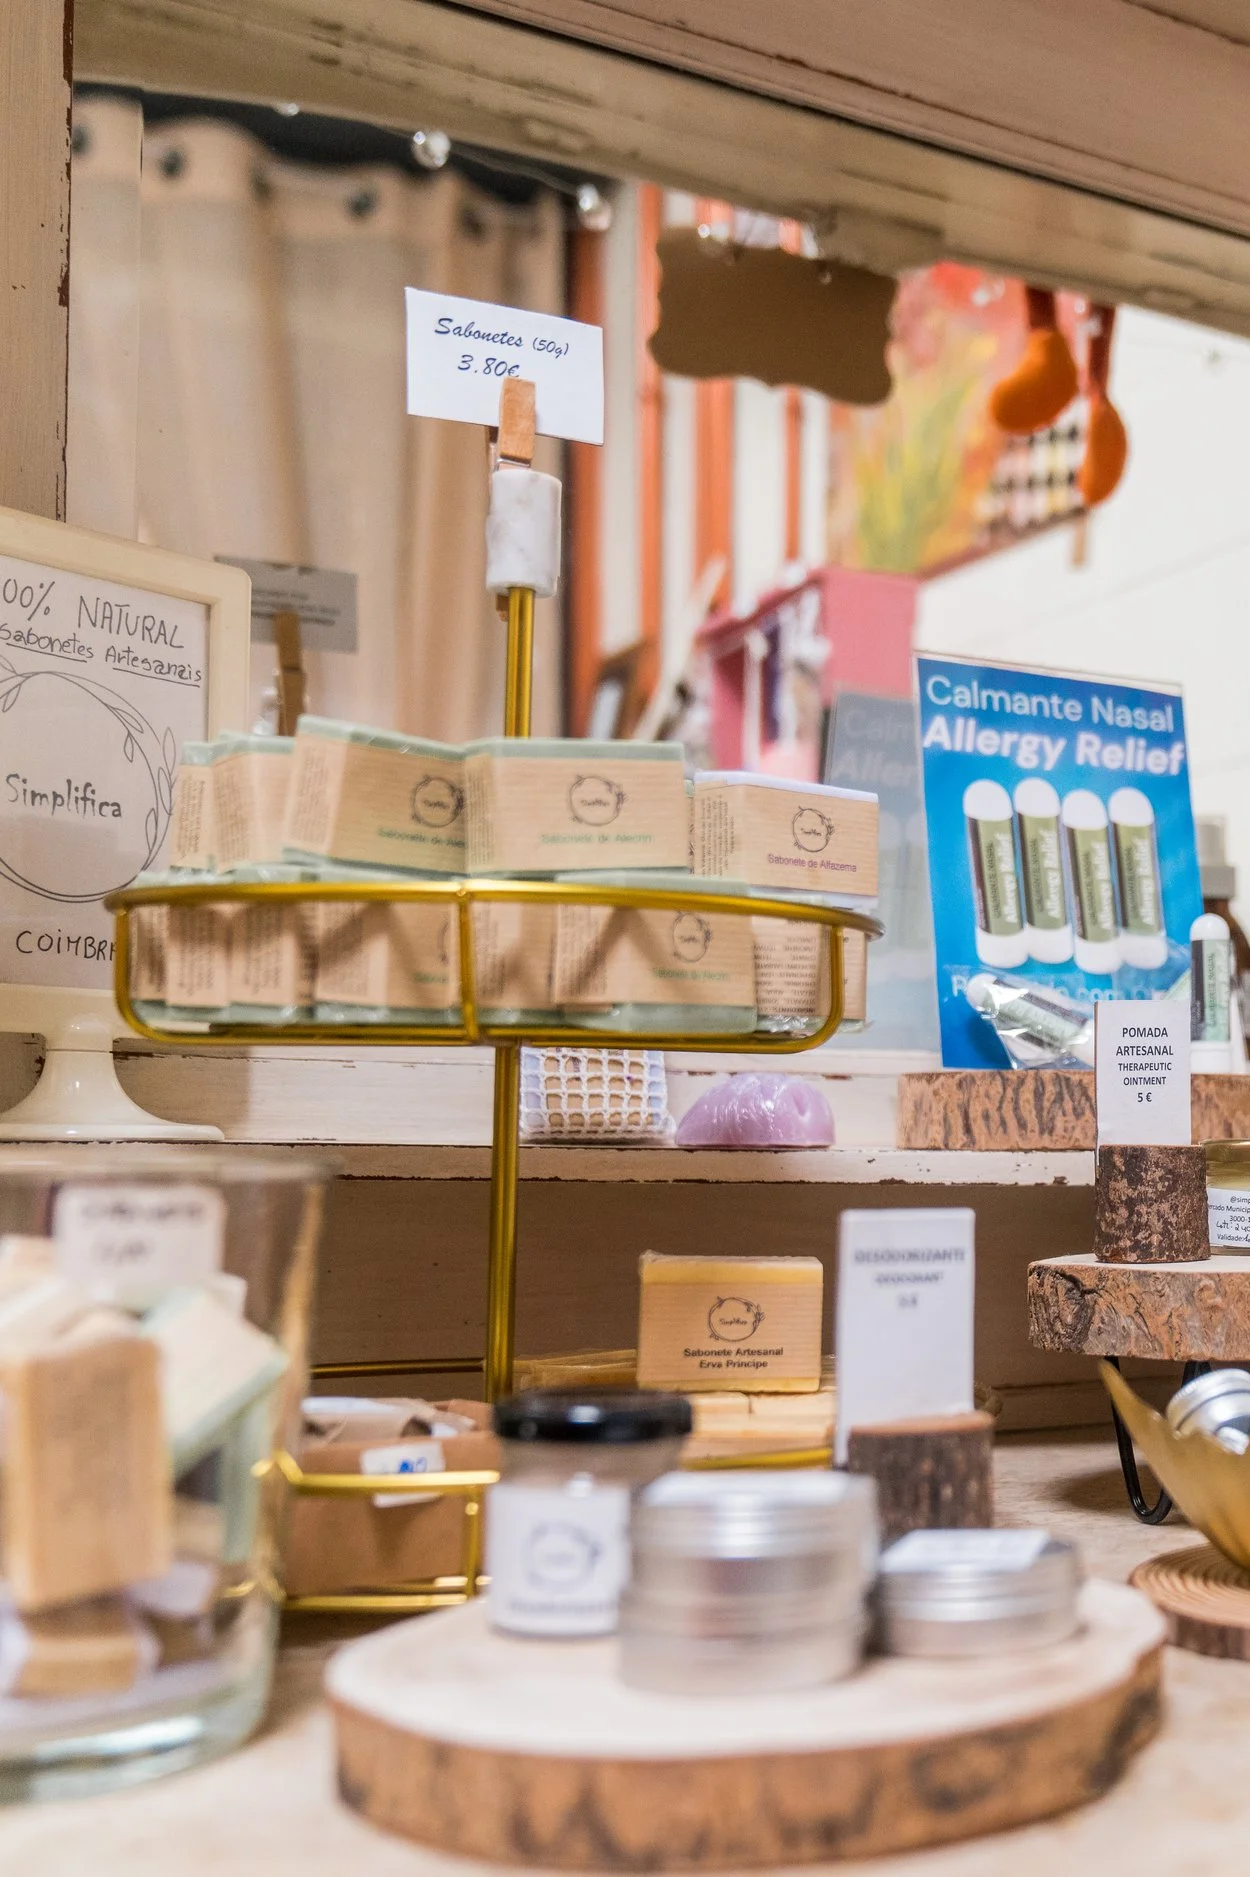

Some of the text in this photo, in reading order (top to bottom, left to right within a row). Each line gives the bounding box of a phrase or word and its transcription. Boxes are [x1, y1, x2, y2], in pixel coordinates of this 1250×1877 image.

[434, 317, 569, 359] Sabonetes (50g)
[457, 354, 520, 378] 3.80€
[3, 578, 184, 649] 00% NATURAL
[0, 623, 202, 682] Sabonetes Artesanais
[926, 674, 1175, 733] Calmante Nasal
[922, 714, 1185, 777] Allergy Relief
[6, 773, 122, 819] Simplifica
[768, 854, 857, 872] Sabonete de Alfazema
[1122, 1027, 1168, 1038] POMADA
[1116, 1045, 1174, 1056] ARTESANAL
[1118, 1062, 1172, 1071] THERAPEUTIC
[1123, 1076, 1167, 1086] OINTMENT
[1137, 1092, 1152, 1102] 5 €
[683, 1347, 784, 1357] Sabonete Artesanal
[699, 1360, 723, 1369] Erva
